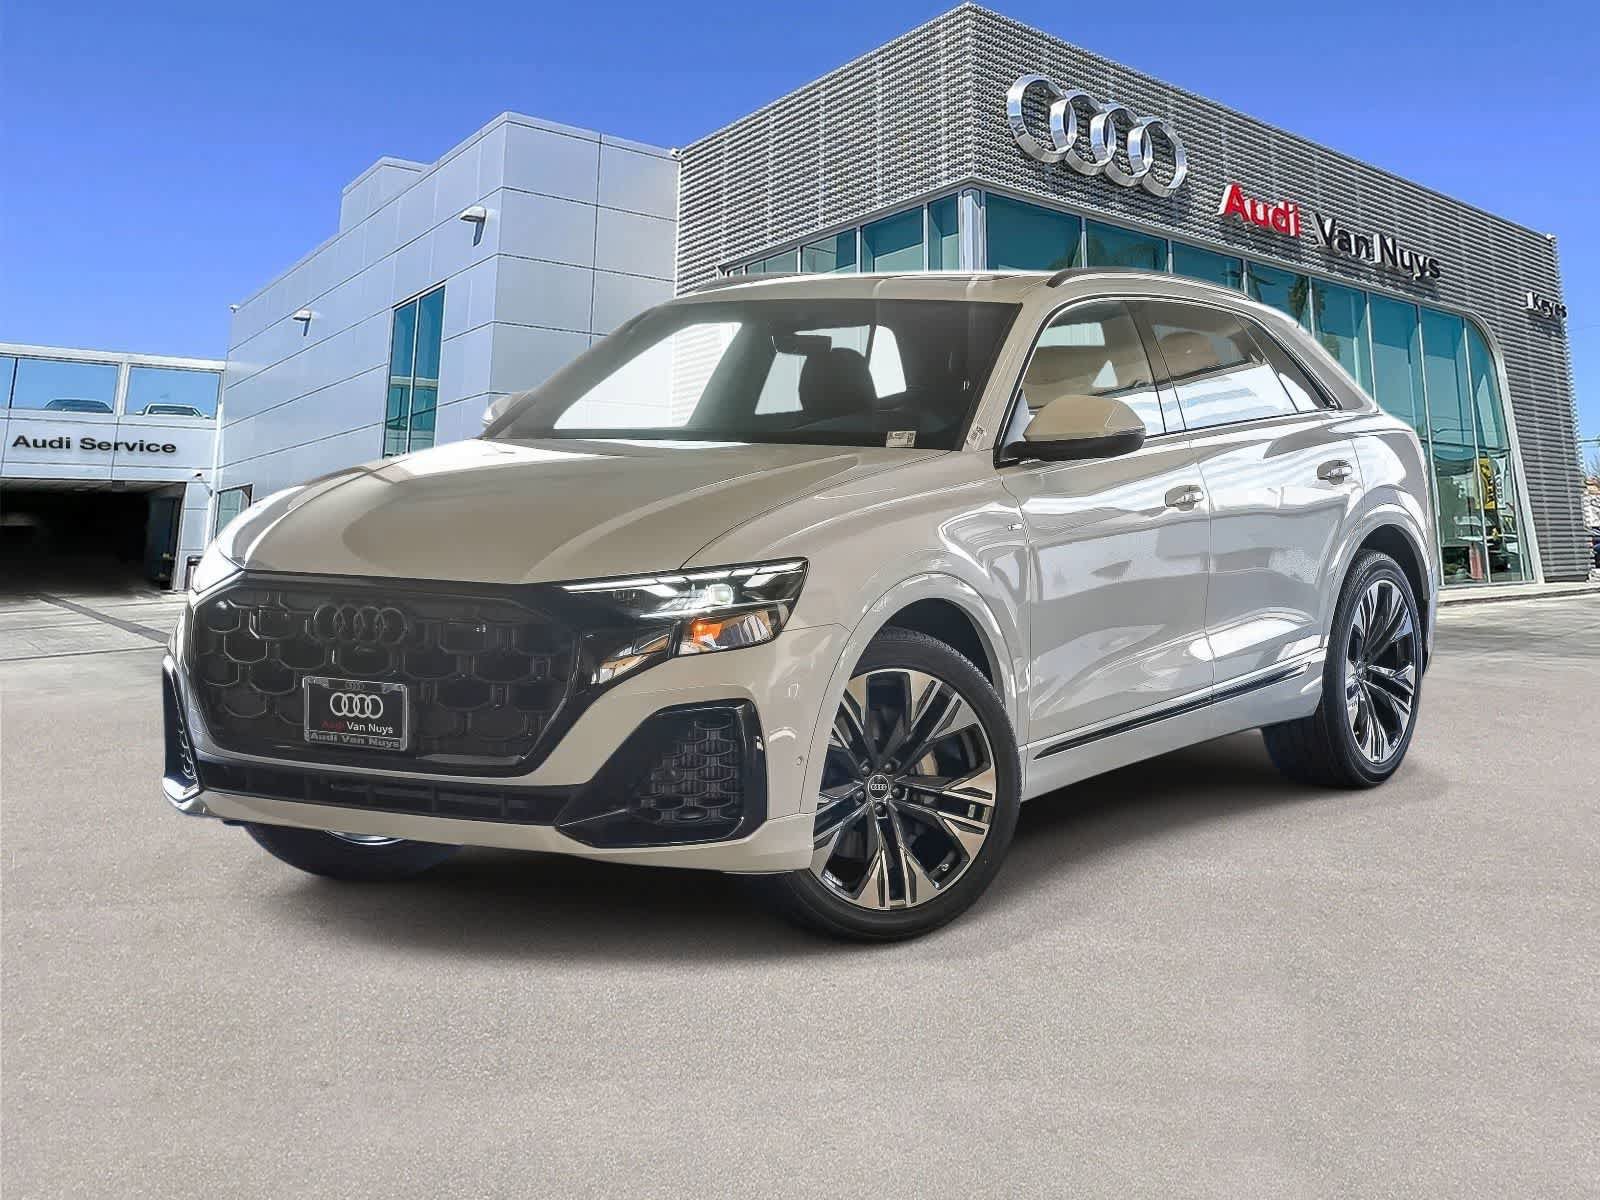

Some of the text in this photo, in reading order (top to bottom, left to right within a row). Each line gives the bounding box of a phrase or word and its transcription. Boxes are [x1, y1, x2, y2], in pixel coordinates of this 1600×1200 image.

[1219, 183, 1440, 280] Audi Van Nuys
[1527, 291, 1568, 318] Keyes
[12, 435, 177, 453] Audi Service
[346, 721, 366, 731] Van
[368, 723, 393, 735] Nuys
[310, 732, 400, 749] Audi Van Nuys
